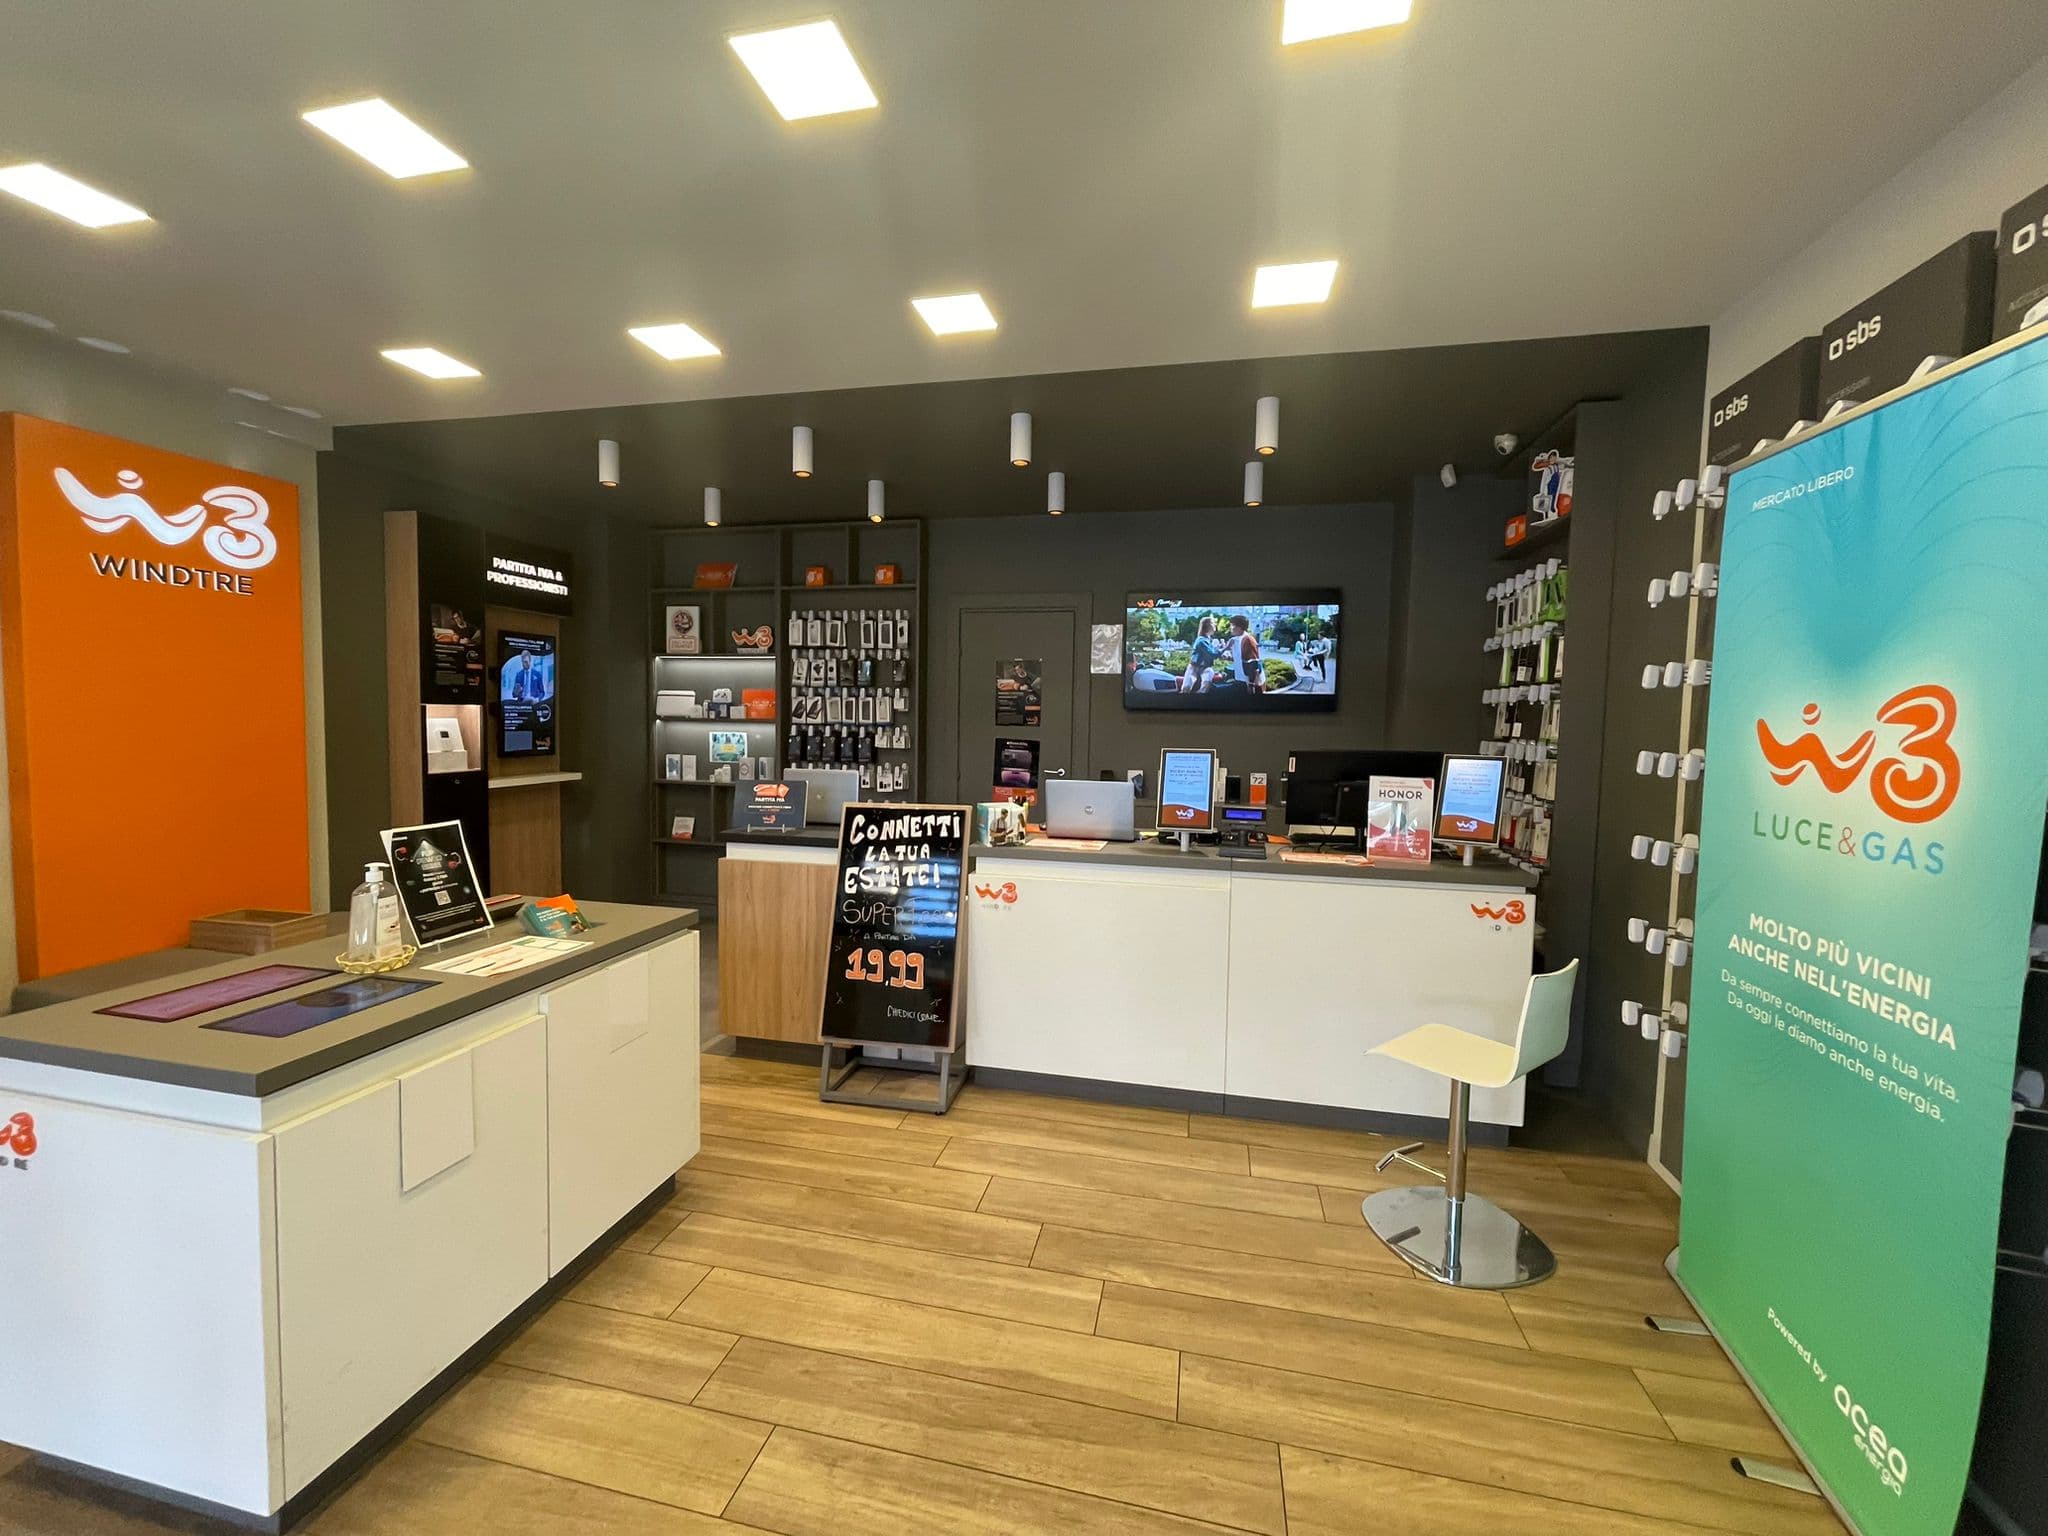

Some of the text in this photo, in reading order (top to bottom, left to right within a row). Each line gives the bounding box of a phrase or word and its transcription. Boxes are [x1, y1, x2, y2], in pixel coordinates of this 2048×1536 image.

[1846, 315, 1882, 351] sbs
[1725, 394, 1749, 421] sbs
[1752, 466, 1855, 512] MERCATO LIBERO
[89, 552, 254, 596] WINDTRE
[486, 570, 568, 596] PROFESSIONISTI
[492, 556, 537, 577] PARTITA
[537, 566, 555, 580] IVA
[1378, 789, 1423, 800] HONOR
[865, 843, 931, 862] LA TUA
[1752, 810, 1946, 875] LUCE&GAS
[844, 863, 941, 894] ESTATE!
[845, 948, 925, 990] 19,99
[1750, 913, 1932, 1000] MOLTO PIÙ VICINI
[1728, 934, 1957, 1050] ANCHE NELL'ENERGIA
[1721, 968, 1960, 1103] Da sempre connettiamo la tua vita.
[1728, 991, 1946, 1123] Da oggi le diamo anche energia.
[1767, 1307, 1828, 1383] Powered by
[1834, 1384, 1908, 1484] acea
[1854, 1433, 1902, 1497] energia
